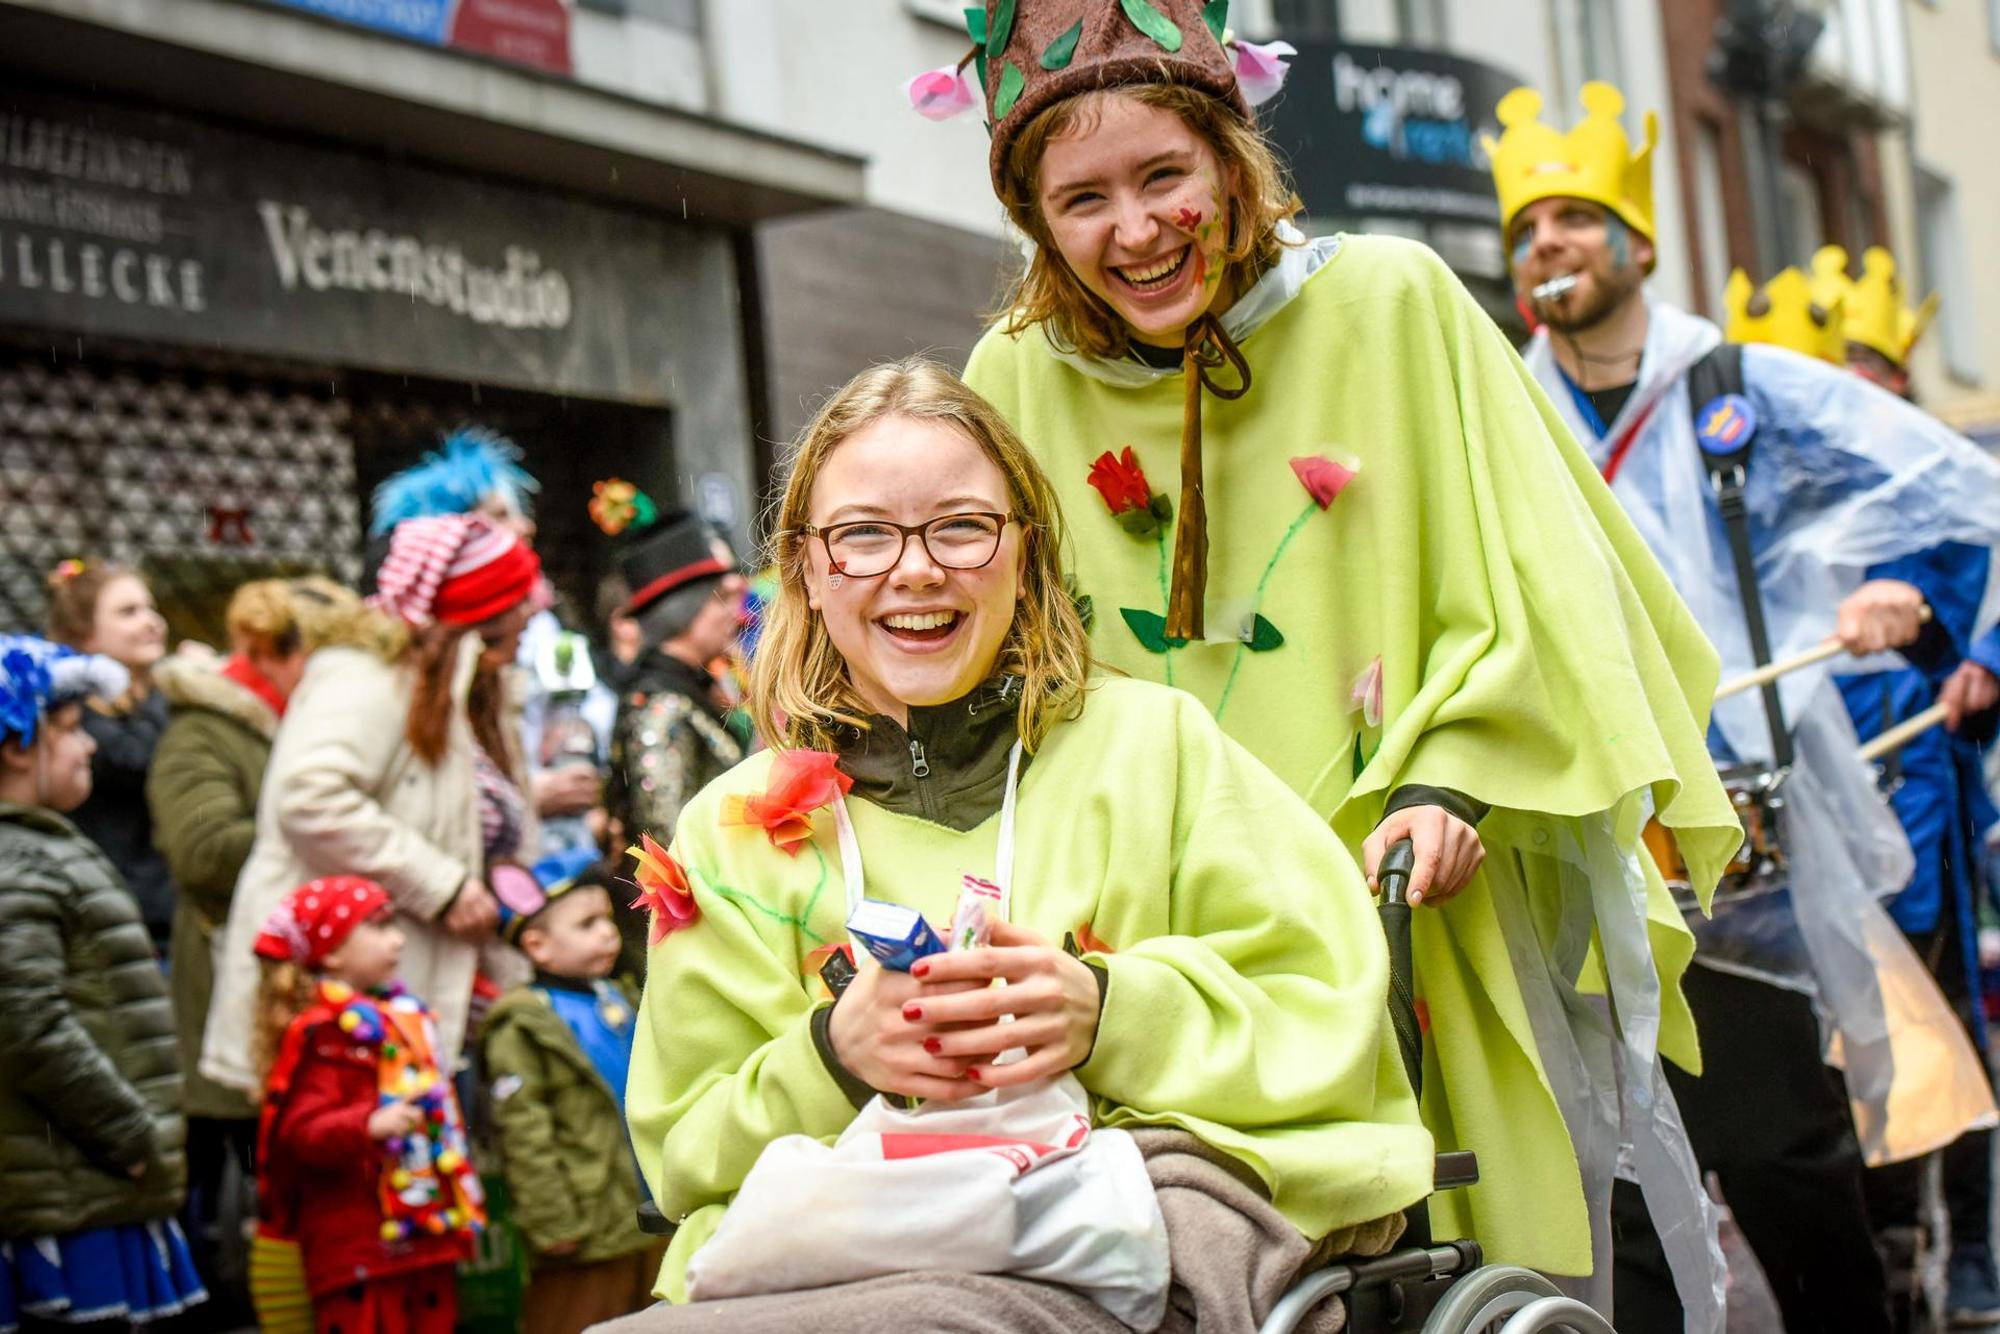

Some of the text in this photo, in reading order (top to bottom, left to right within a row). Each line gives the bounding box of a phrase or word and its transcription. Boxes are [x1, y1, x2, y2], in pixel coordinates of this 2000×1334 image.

[1333, 52, 1463, 120] home
[0, 233, 207, 312] LLECKE
[258, 200, 570, 328] Venenstudio
